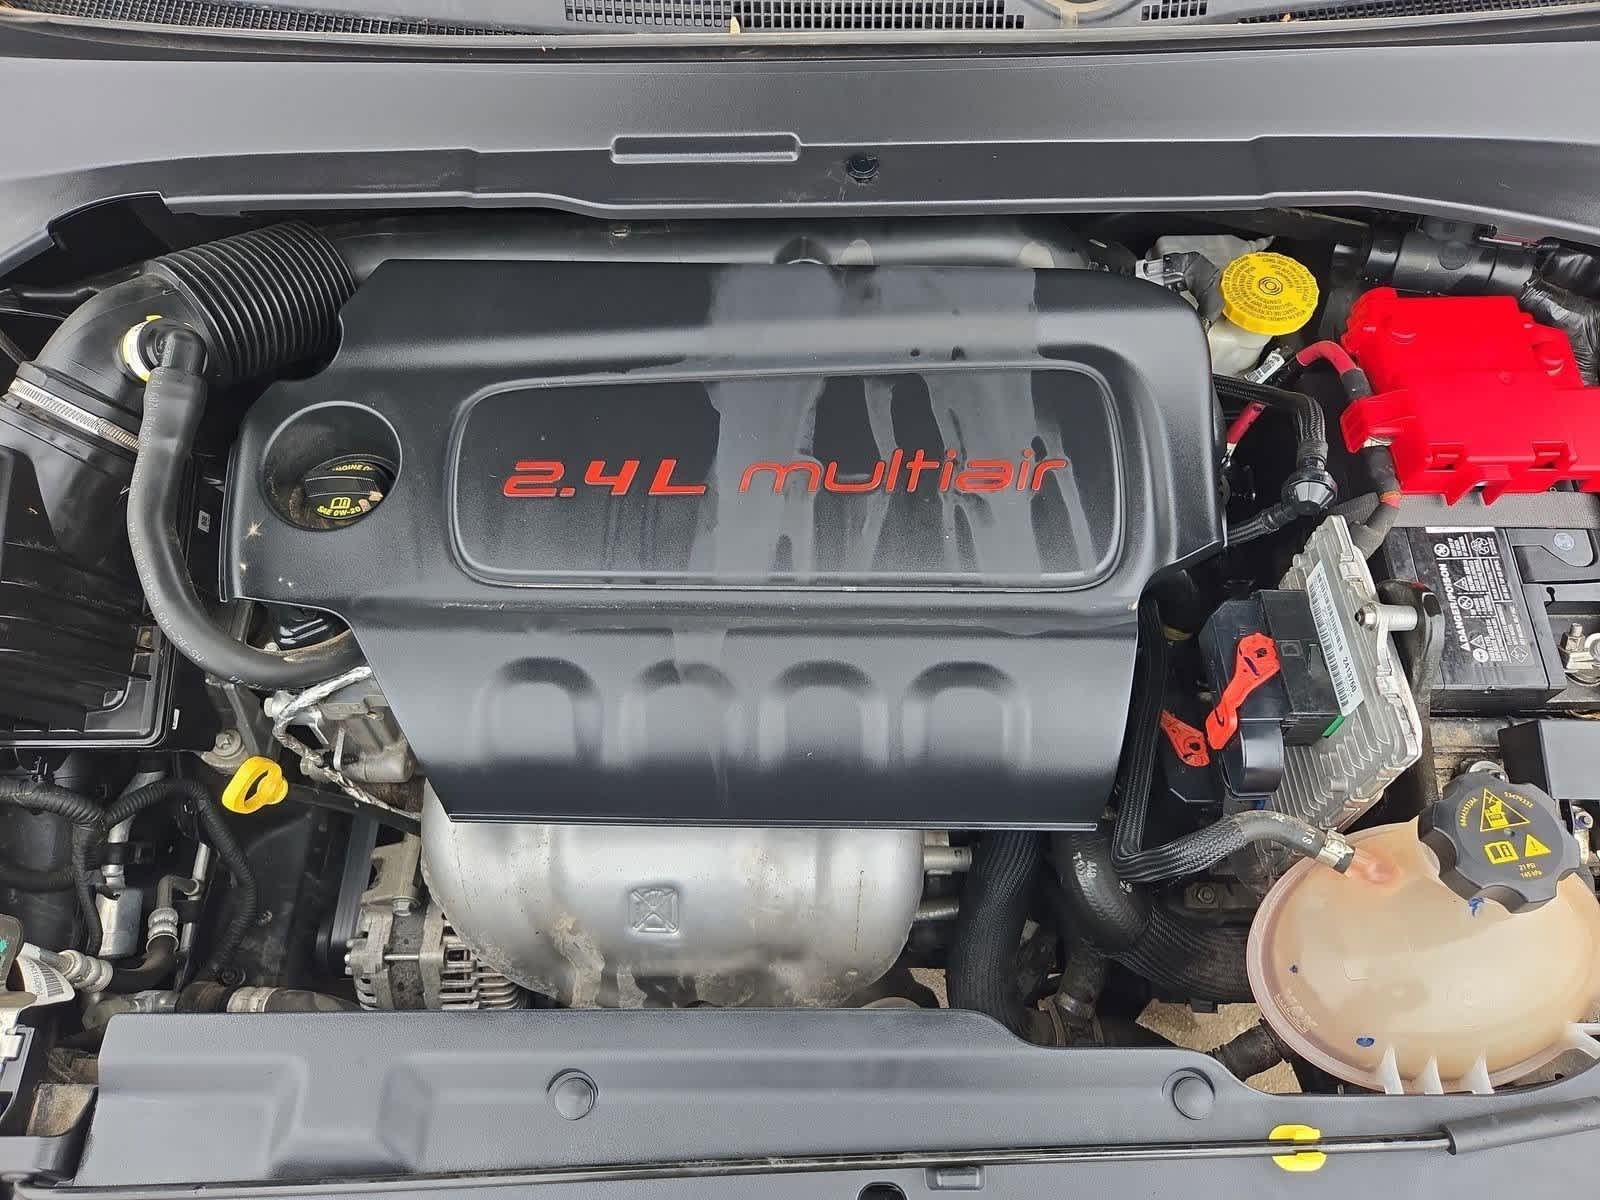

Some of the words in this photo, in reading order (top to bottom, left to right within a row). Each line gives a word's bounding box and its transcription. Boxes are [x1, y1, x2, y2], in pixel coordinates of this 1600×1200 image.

[738, 449, 1069, 494] multiair
[333, 506, 361, 516] 0W-20
[1439, 564, 1469, 642] DANGER/POISON
